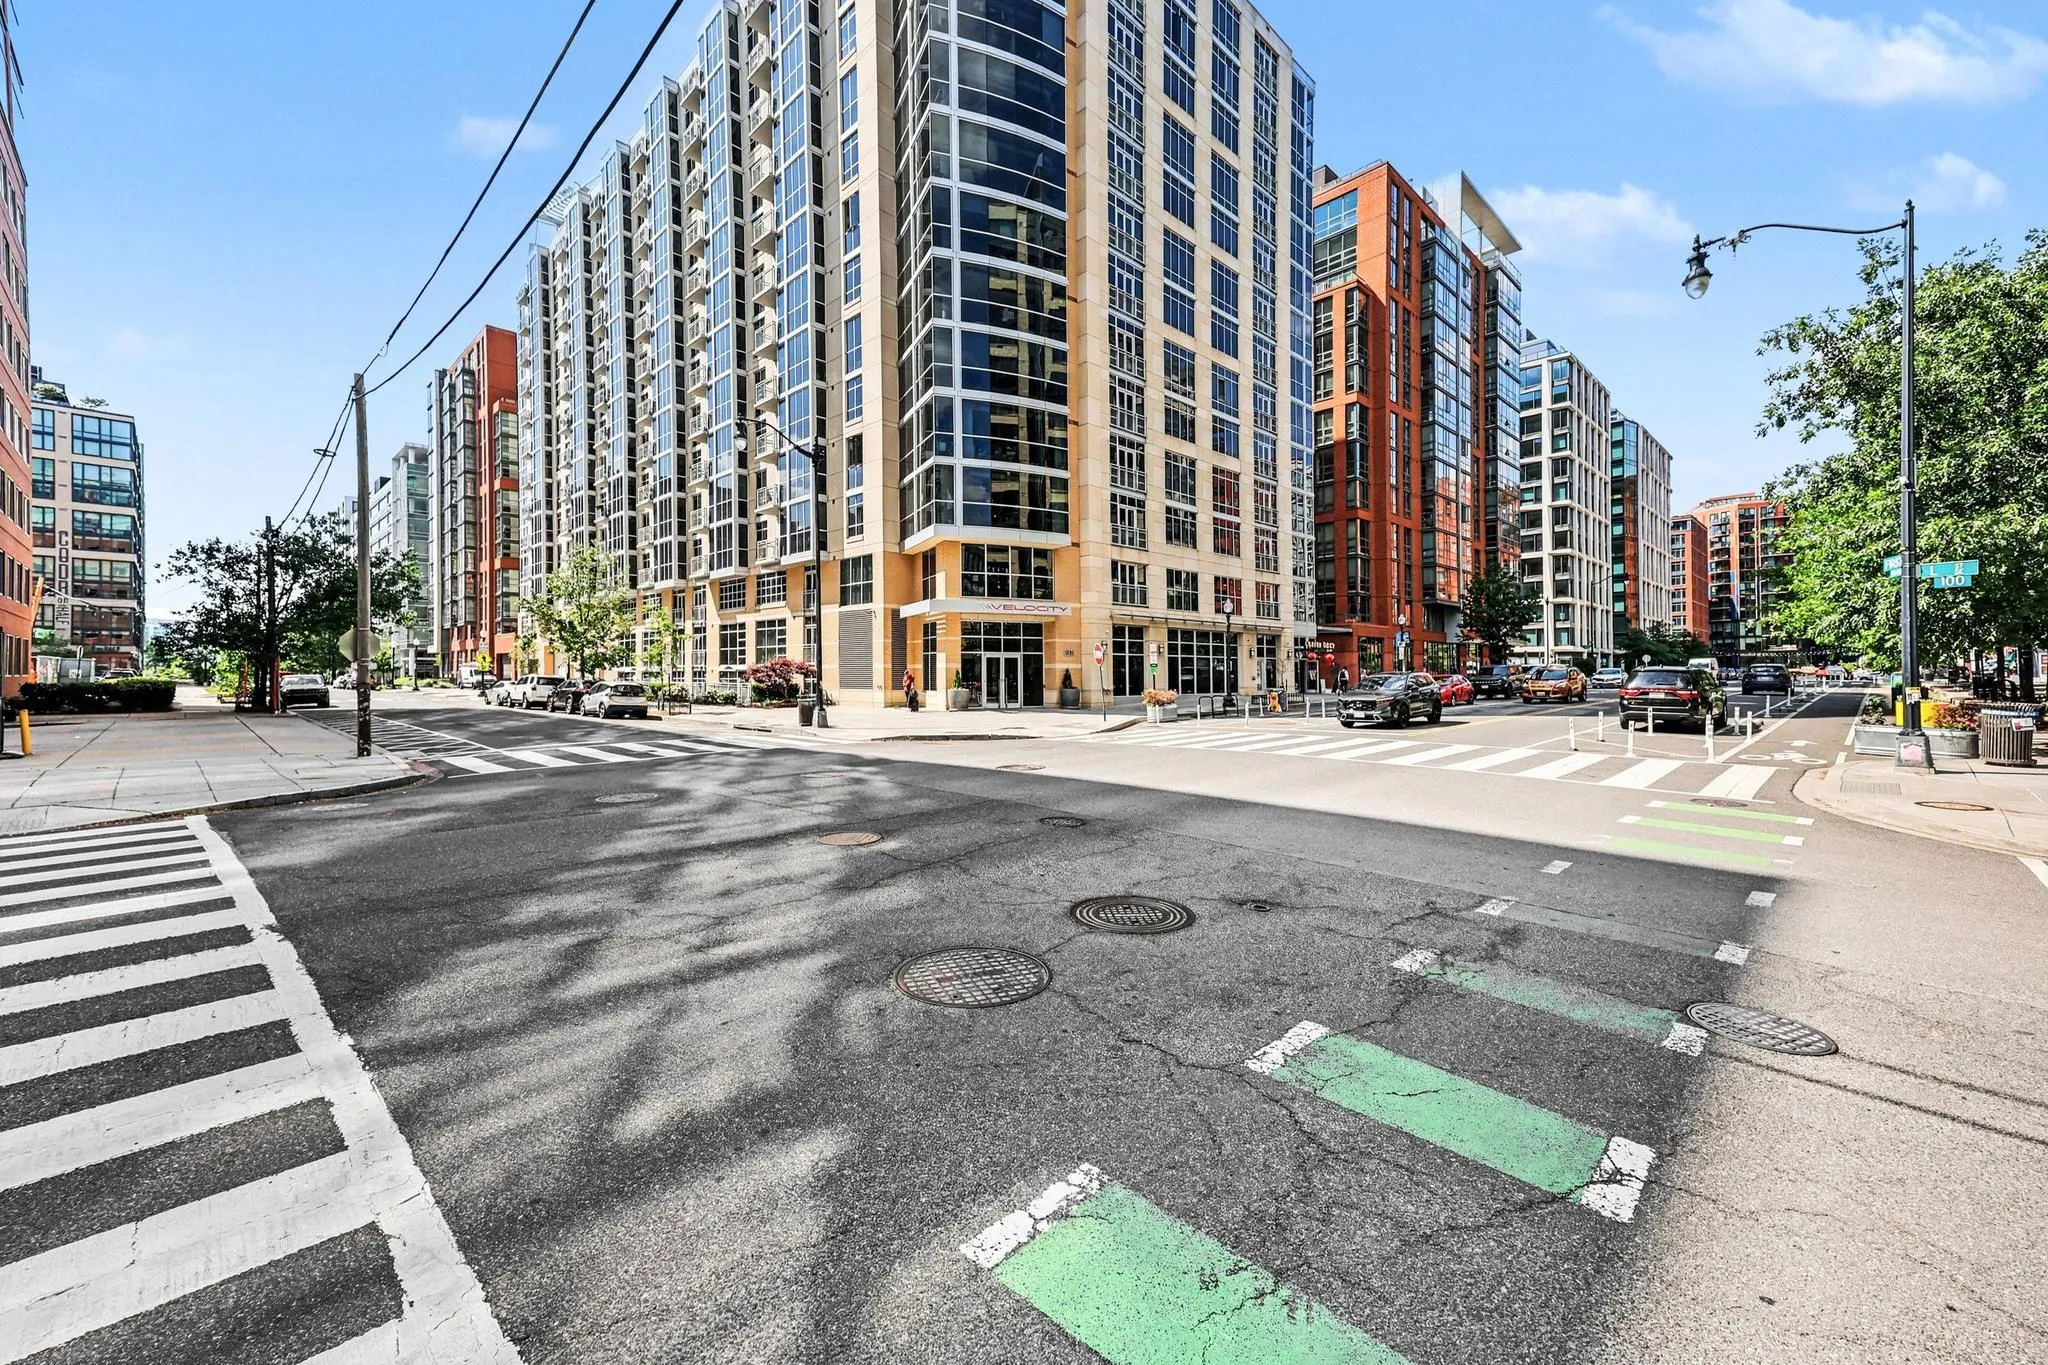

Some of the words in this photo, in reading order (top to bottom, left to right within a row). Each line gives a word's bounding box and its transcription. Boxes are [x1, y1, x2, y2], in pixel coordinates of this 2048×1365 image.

[1929, 565, 1939, 576] L
[1941, 575, 1965, 586] 100
[991, 604, 1068, 612] VELOCITY
